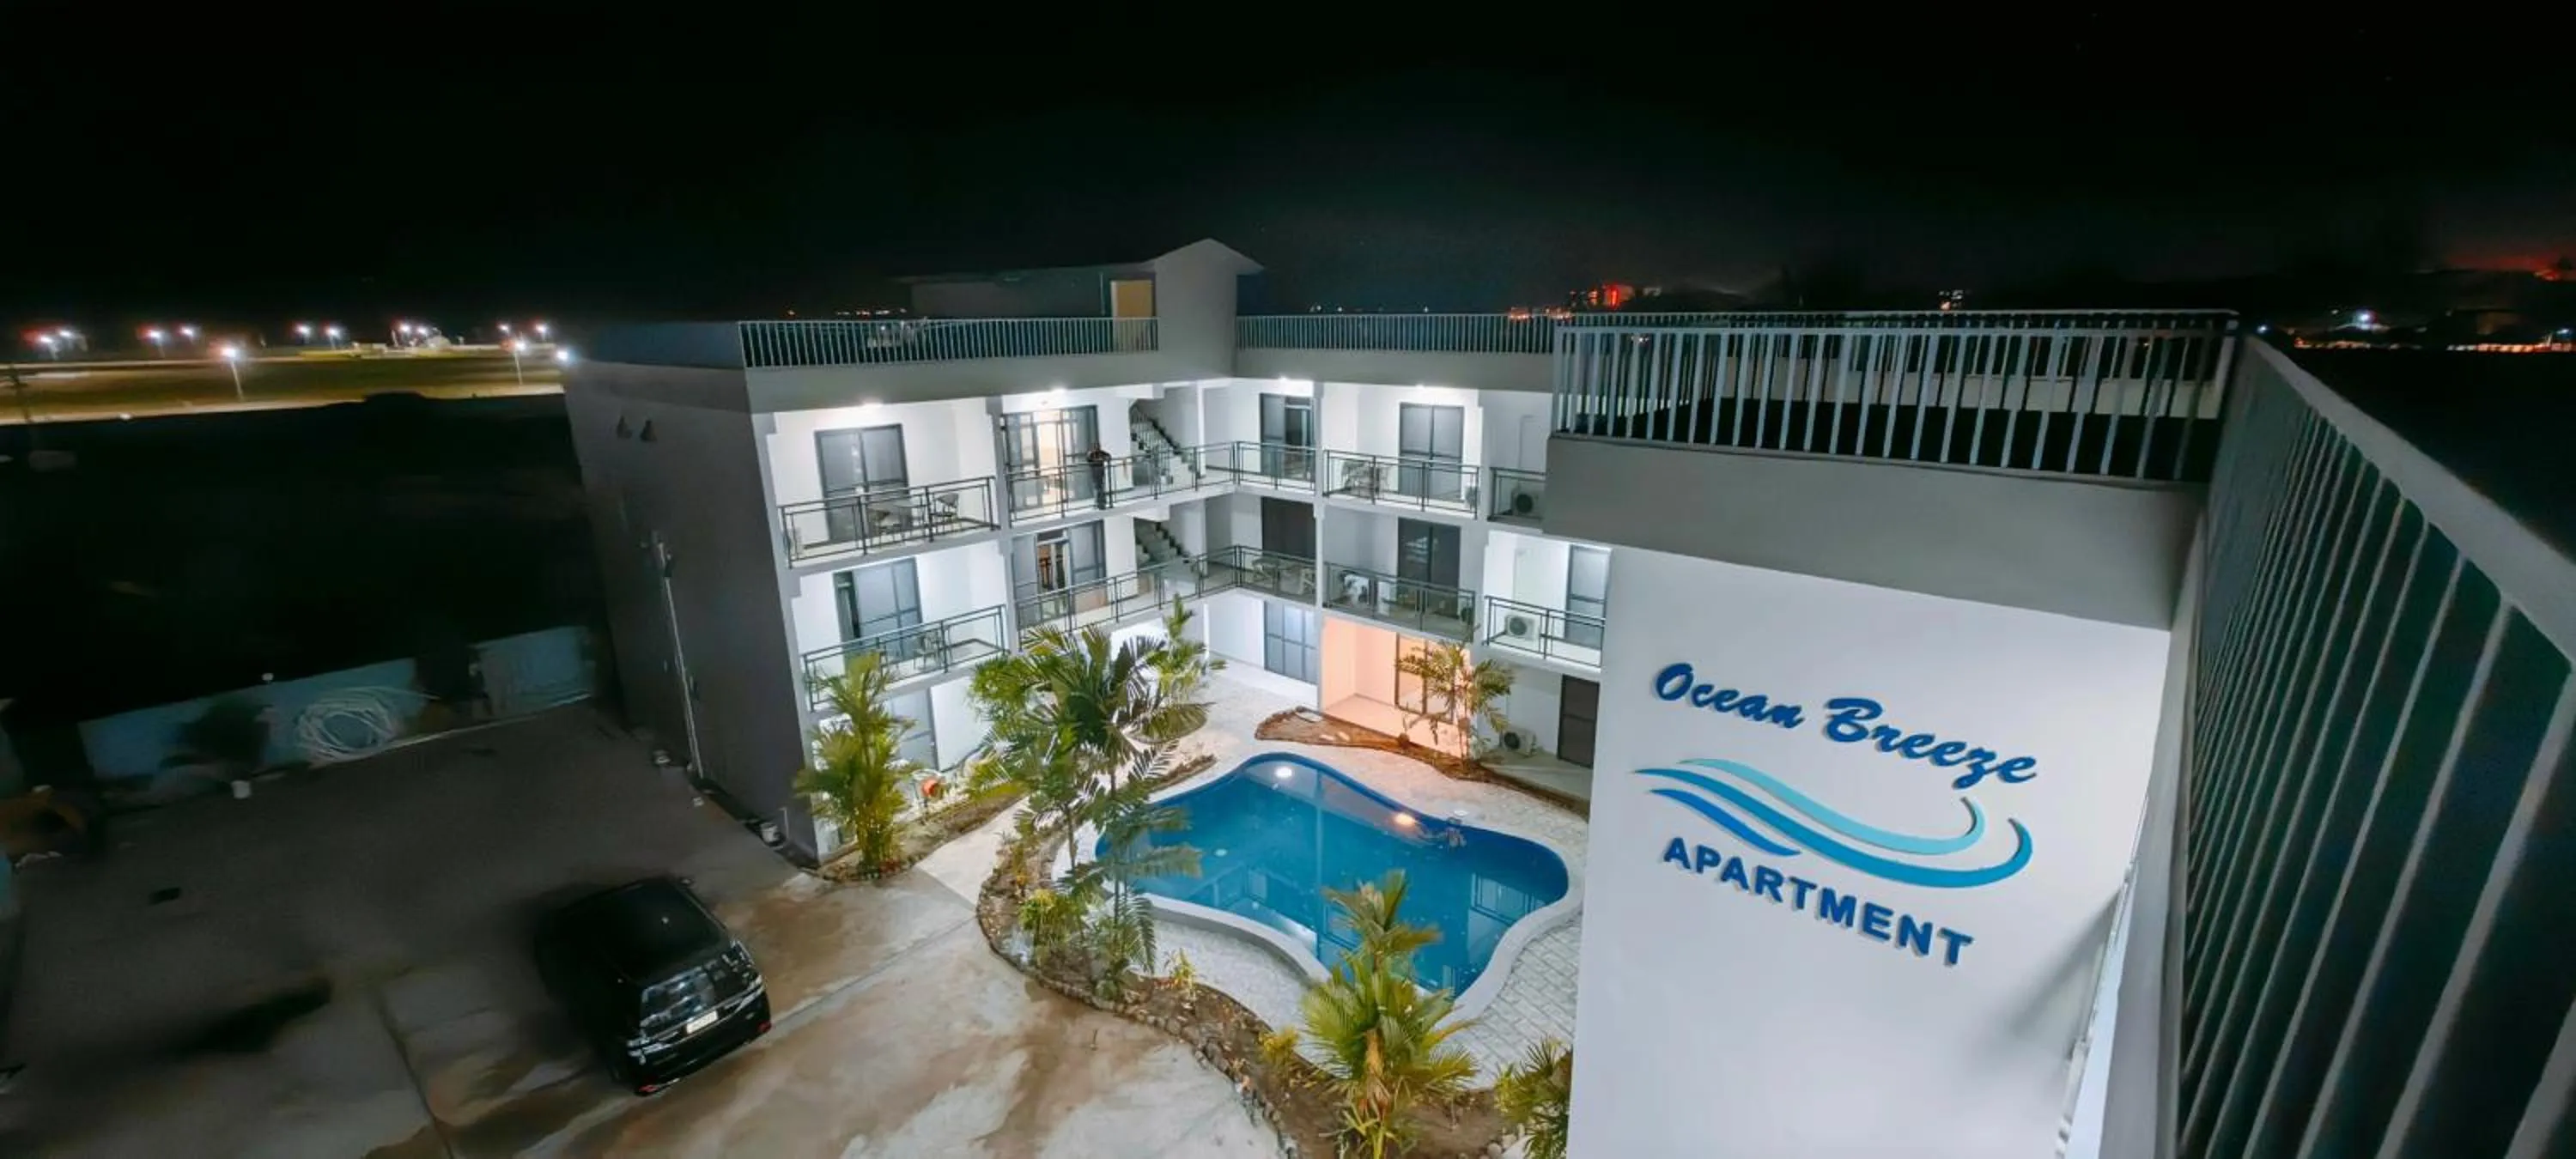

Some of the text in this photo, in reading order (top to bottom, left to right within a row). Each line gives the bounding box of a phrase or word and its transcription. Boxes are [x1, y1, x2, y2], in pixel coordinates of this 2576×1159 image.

[1654, 663, 2037, 789] Ocean Breeze
[1662, 837, 1975, 966] APARTMENT
